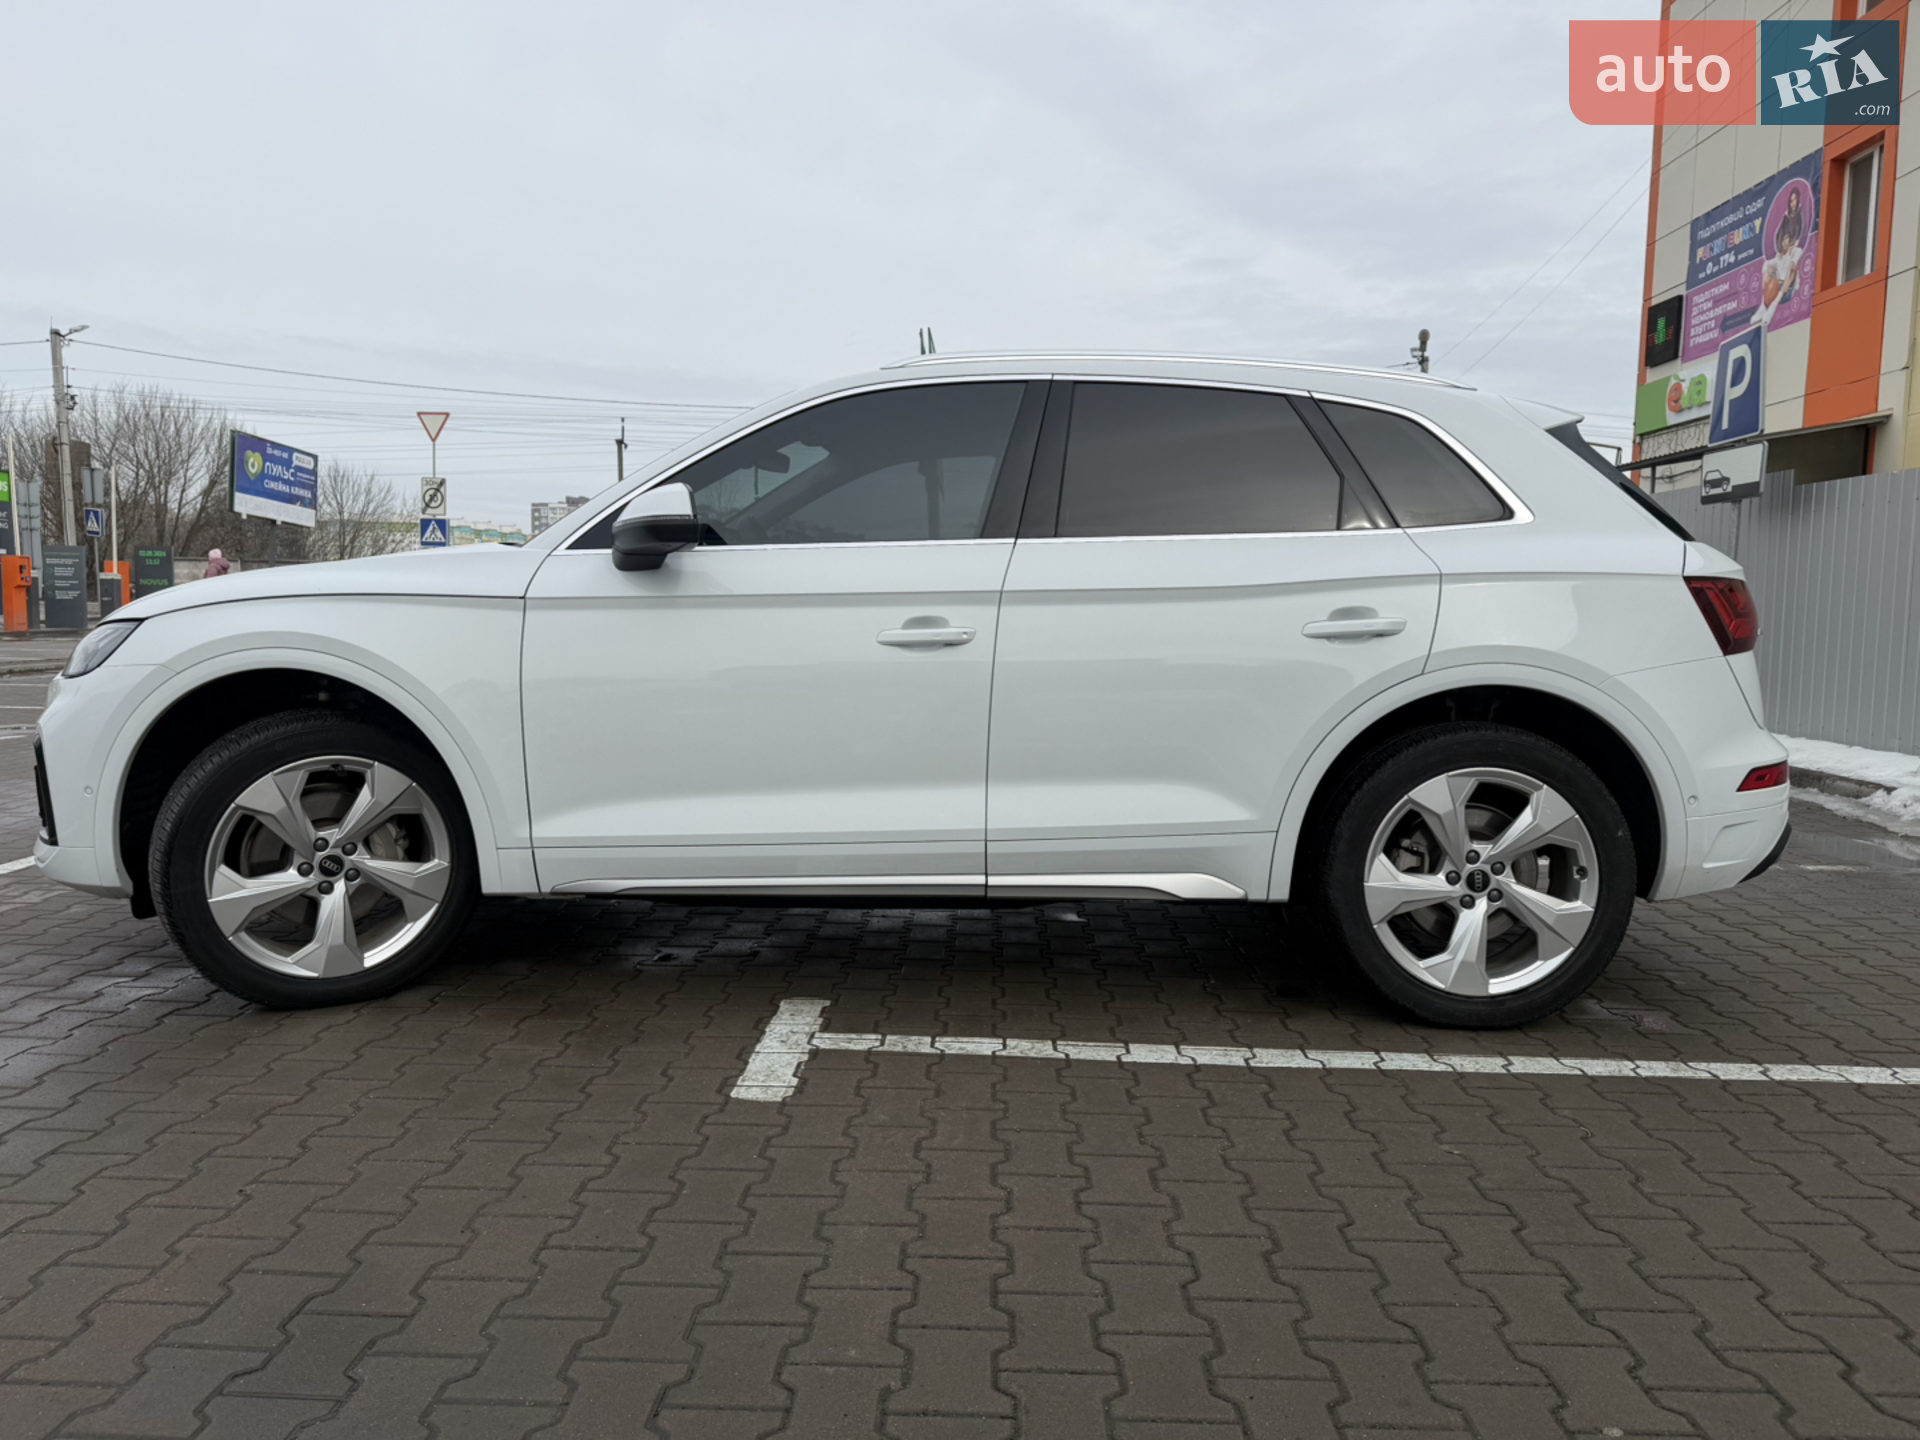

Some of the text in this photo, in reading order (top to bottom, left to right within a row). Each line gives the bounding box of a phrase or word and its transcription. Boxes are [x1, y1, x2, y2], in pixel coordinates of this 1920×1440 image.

[1744, 195, 1766, 216] ОДЯГ
[1727, 216, 1763, 249] BUNNY
[1706, 261, 1713, 275] 0
[1719, 250, 1736, 269] 174
[1692, 281, 1730, 306] ПІДЛІТКАМ
[1690, 299, 1713, 318] ДІТЯМ
[1690, 299, 1738, 327] НЕМОВЛЯТАМ
[1689, 319, 1716, 338] ВЗУТТЯ
[1721, 343, 1752, 431] P
[264, 461, 295, 481] ПУЛЬС
[263, 479, 290, 494] СІМЕЙНА
[290, 485, 312, 498] КЛІНІКА
[140, 578, 169, 586] NOVUS
